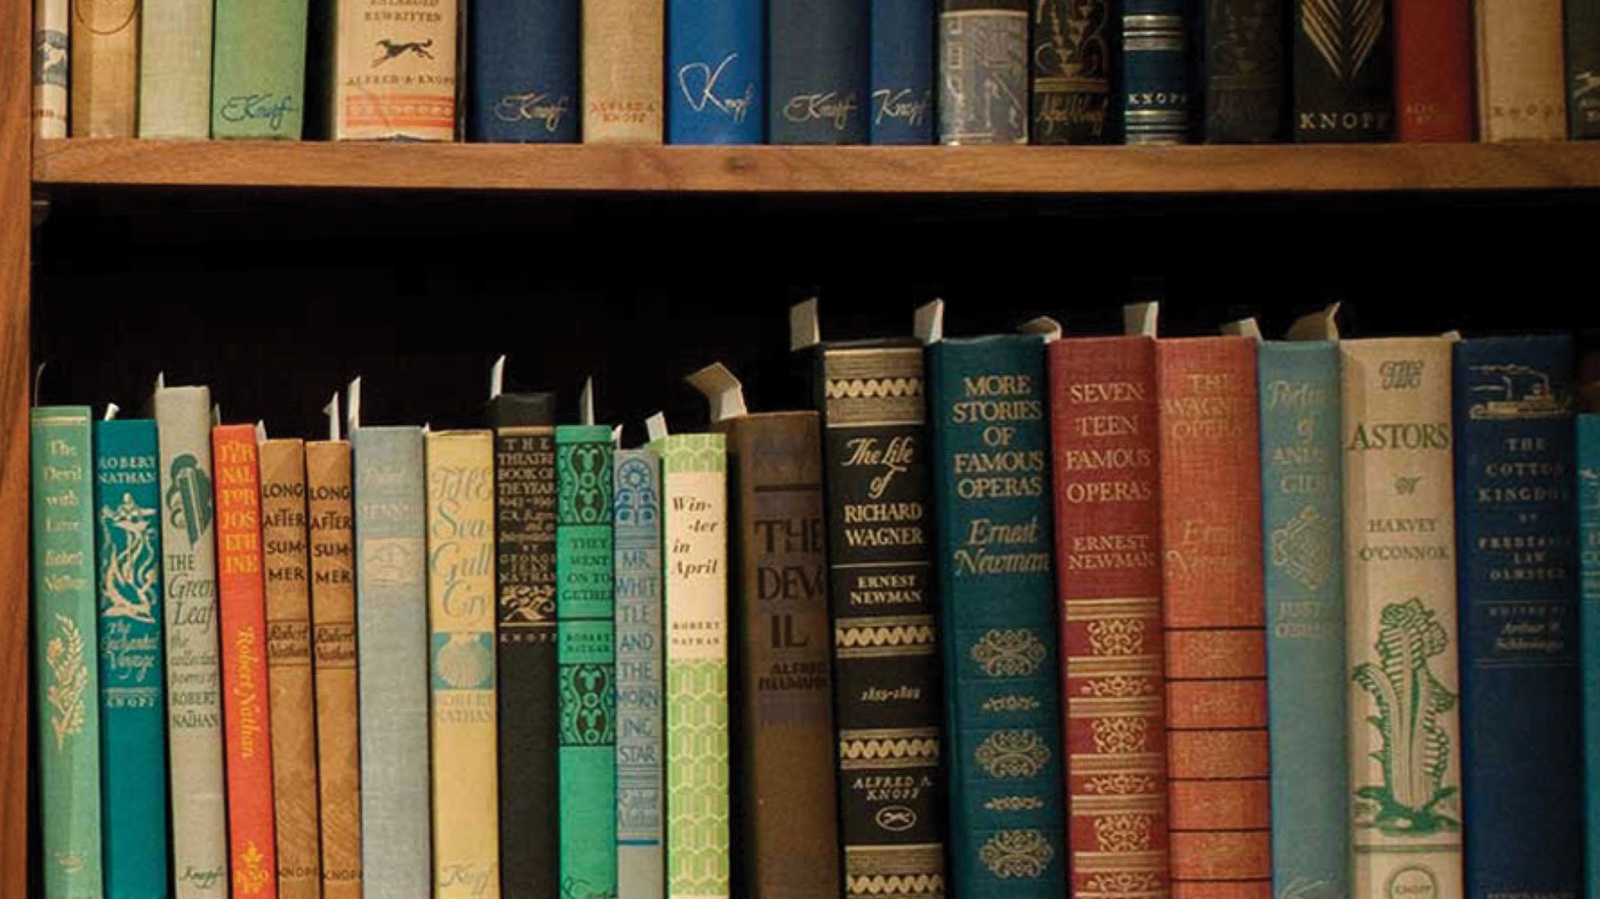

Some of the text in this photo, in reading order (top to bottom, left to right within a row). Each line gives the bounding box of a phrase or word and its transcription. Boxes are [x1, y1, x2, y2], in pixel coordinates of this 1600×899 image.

[963, 375, 1031, 396] MORE
[1069, 382, 1143, 404] SEVEN
[953, 401, 1042, 423] STORIES
[1075, 415, 1139, 436] TEEN
[507, 438, 549, 450] THE
[983, 425, 1016, 446] OF
[1344, 423, 1451, 451] ASTORS
[1504, 438, 1548, 451] THE
[842, 436, 914, 467] The Life
[1066, 449, 1149, 470] FAMOUS
[954, 451, 1043, 473] FAMOUS
[868, 463, 907, 499] of
[958, 477, 1042, 499] OPERAS
[263, 483, 305, 498] LONG
[310, 485, 350, 500] LONG
[1066, 482, 1152, 503] OPERAS
[264, 509, 306, 528] AFTER
[311, 511, 351, 531] AFTER
[433, 499, 486, 540] Sea
[845, 503, 922, 524] RICHARD
[968, 515, 1038, 546] Ernest
[1369, 518, 1436, 532] HARVEY
[570, 538, 608, 549] THEY
[673, 538, 690, 553] in
[845, 527, 924, 547] WAGNER
[1073, 535, 1149, 551] ERNEST
[168, 554, 195, 571] THE
[570, 556, 609, 566] WENT
[953, 547, 1049, 576] Newman
[1068, 553, 1158, 569] NEWMAN
[1357, 546, 1449, 561] O'CONNOR
[269, 568, 306, 582] MER
[316, 570, 352, 584] MER
[567, 572, 588, 583] ON
[857, 576, 915, 589] ERNEST
[850, 592, 921, 605] NEWMAN
[173, 602, 214, 634] Leaf
[621, 605, 648, 623] TLE
[771, 615, 807, 649] IL
[621, 633, 653, 650] AND
[621, 662, 652, 679] THE
[854, 777, 914, 789] ALFRED
[866, 788, 919, 801] KNOPF
